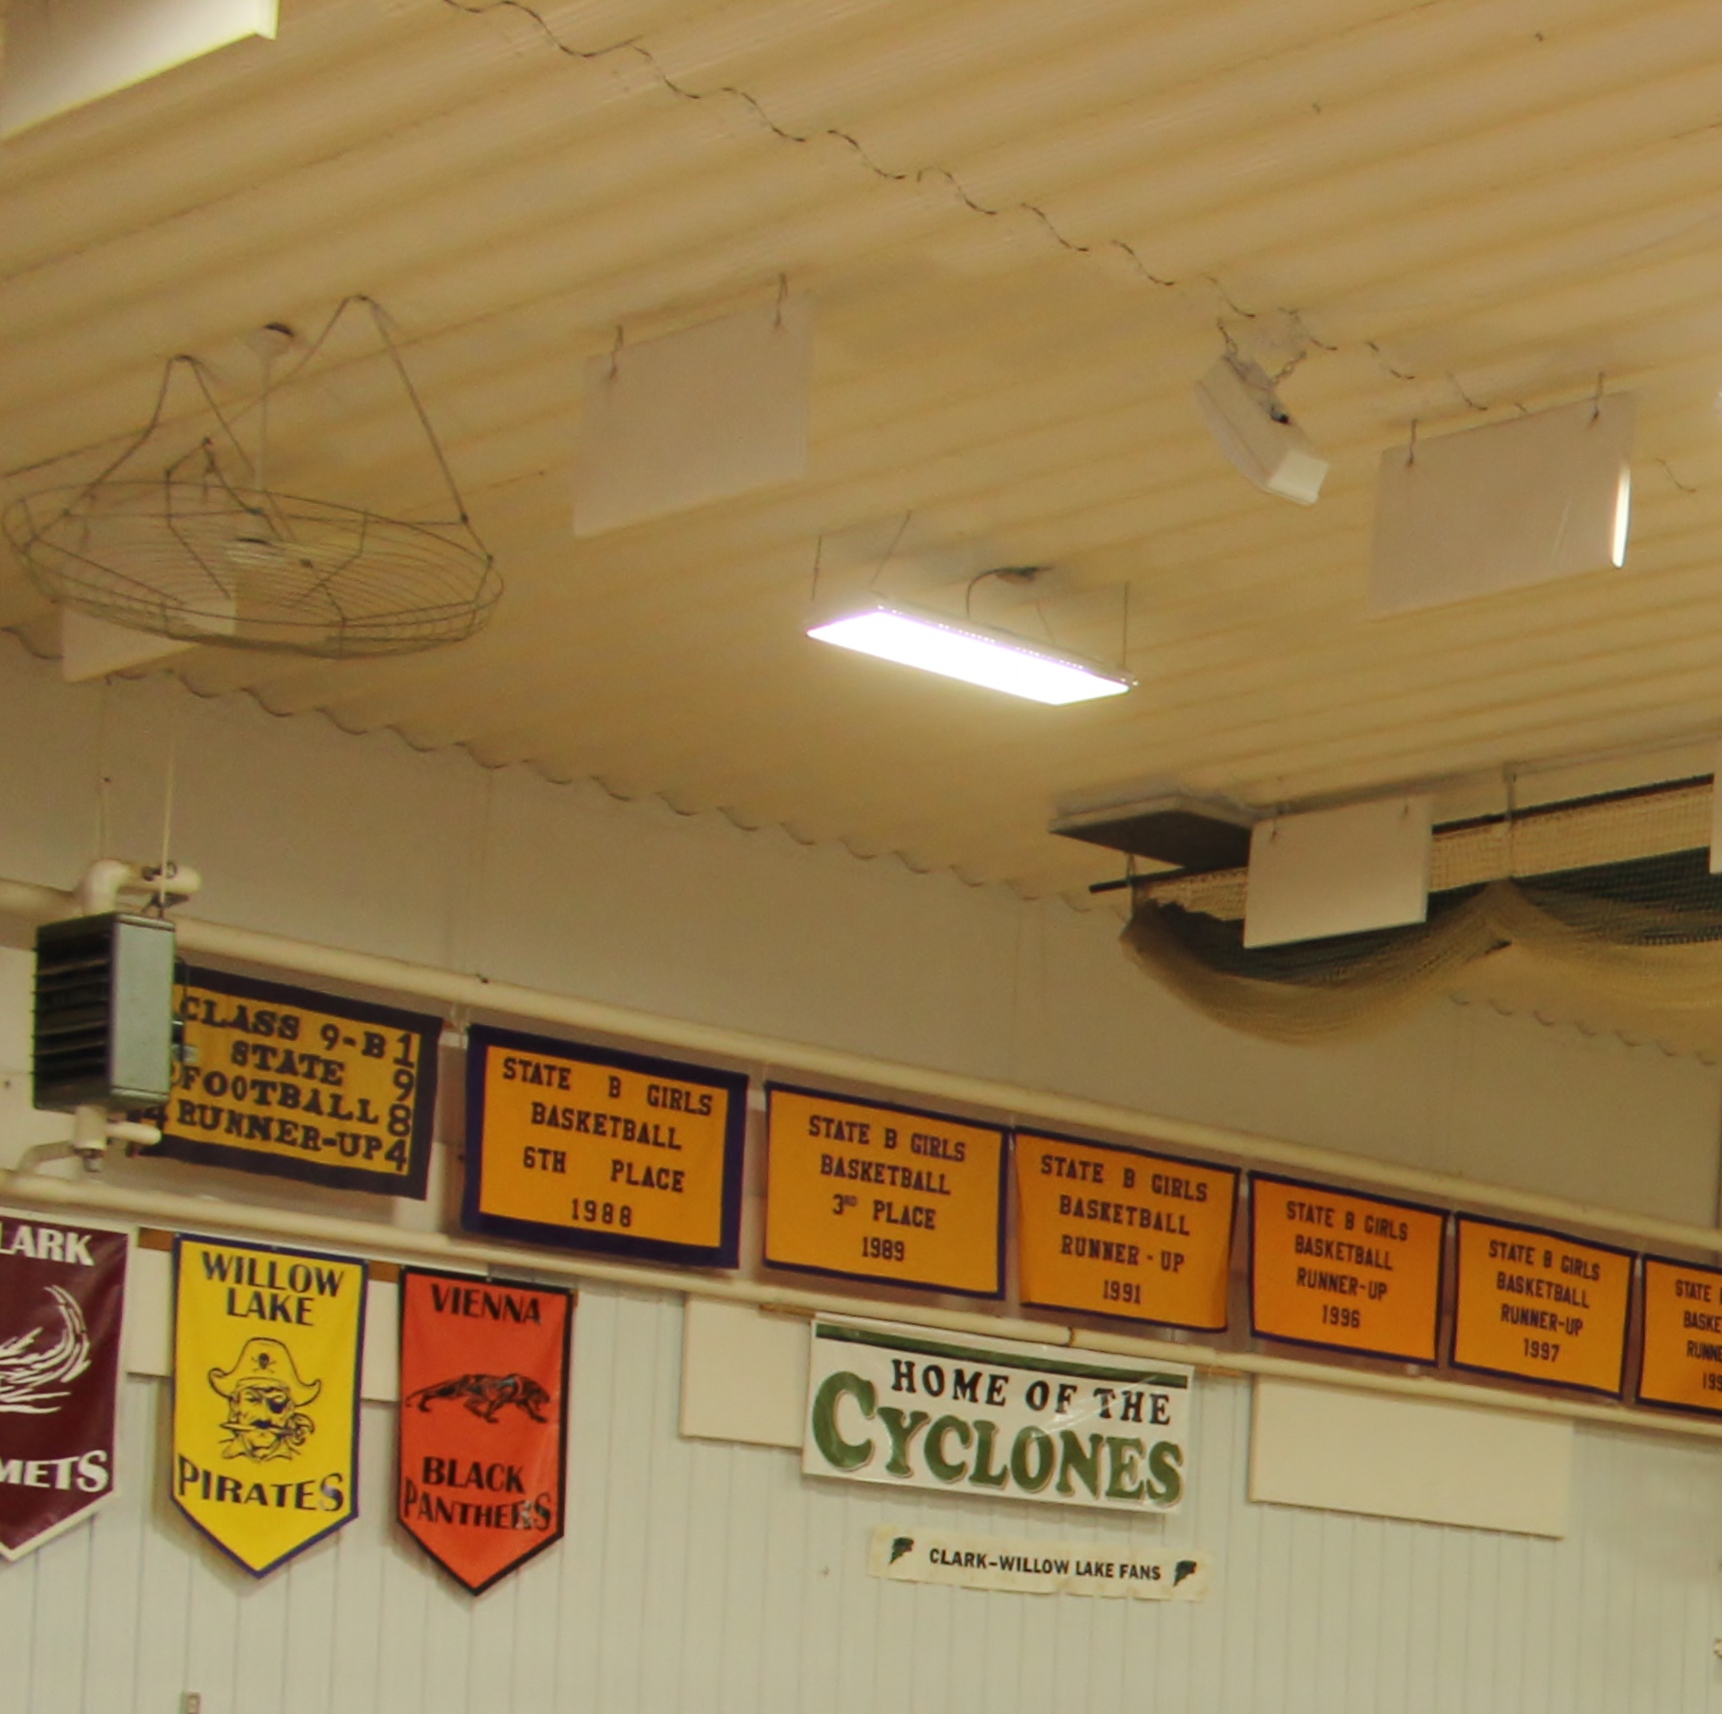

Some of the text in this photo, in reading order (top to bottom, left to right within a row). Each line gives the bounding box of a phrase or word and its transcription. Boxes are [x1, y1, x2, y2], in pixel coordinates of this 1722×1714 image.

[180, 996, 385, 1058] CLASS 9-B
[231, 1040, 344, 1086] STATE
[182, 1065, 378, 1124] FOOTBALL
[503, 1057, 712, 1116] STATE B GIRLS
[177, 1100, 383, 1160] RUNNER-UP
[531, 1102, 681, 1150] BASKETBALL
[808, 1115, 966, 1162] STATE B GIRLS
[524, 1146, 685, 1193] 6TH PLACE
[820, 1154, 951, 1196] BASKETBALL
[1041, 1156, 1207, 1202] STATE B GIRLS
[572, 1198, 632, 1227] 1988
[873, 1200, 936, 1230] PLACE
[1059, 1194, 1191, 1237] BASKETBALL
[1286, 1200, 1408, 1242] STATE B GIRLS
[861, 1237, 905, 1261] 1989
[1295, 1235, 1393, 1271] BASKETBALL
[1489, 1239, 1600, 1281] STATE B GIRLS
[202, 1251, 345, 1298] WILLOW
[1103, 1280, 1142, 1304] 1991
[1297, 1267, 1387, 1301] RUNNER-UP
[1496, 1271, 1590, 1309] BASKETBALL
[1675, 1279, 1712, 1303] STATE
[227, 1287, 315, 1327] LAKE
[431, 1284, 542, 1325] VIENNA
[1321, 1304, 1360, 1329] 1996
[1501, 1303, 1583, 1337] RUNNER-UP
[1523, 1338, 1560, 1363] 1997
[891, 1359, 1171, 1426] HOME OF THE
[812, 1371, 1183, 1506] CYCLONES
[178, 1453, 345, 1513] PIRATES
[423, 1456, 526, 1494] BLACK
[404, 1476, 552, 1531] PANTHERS
[929, 1548, 1161, 1580] CLARK-WILLOW LAKE FANS
